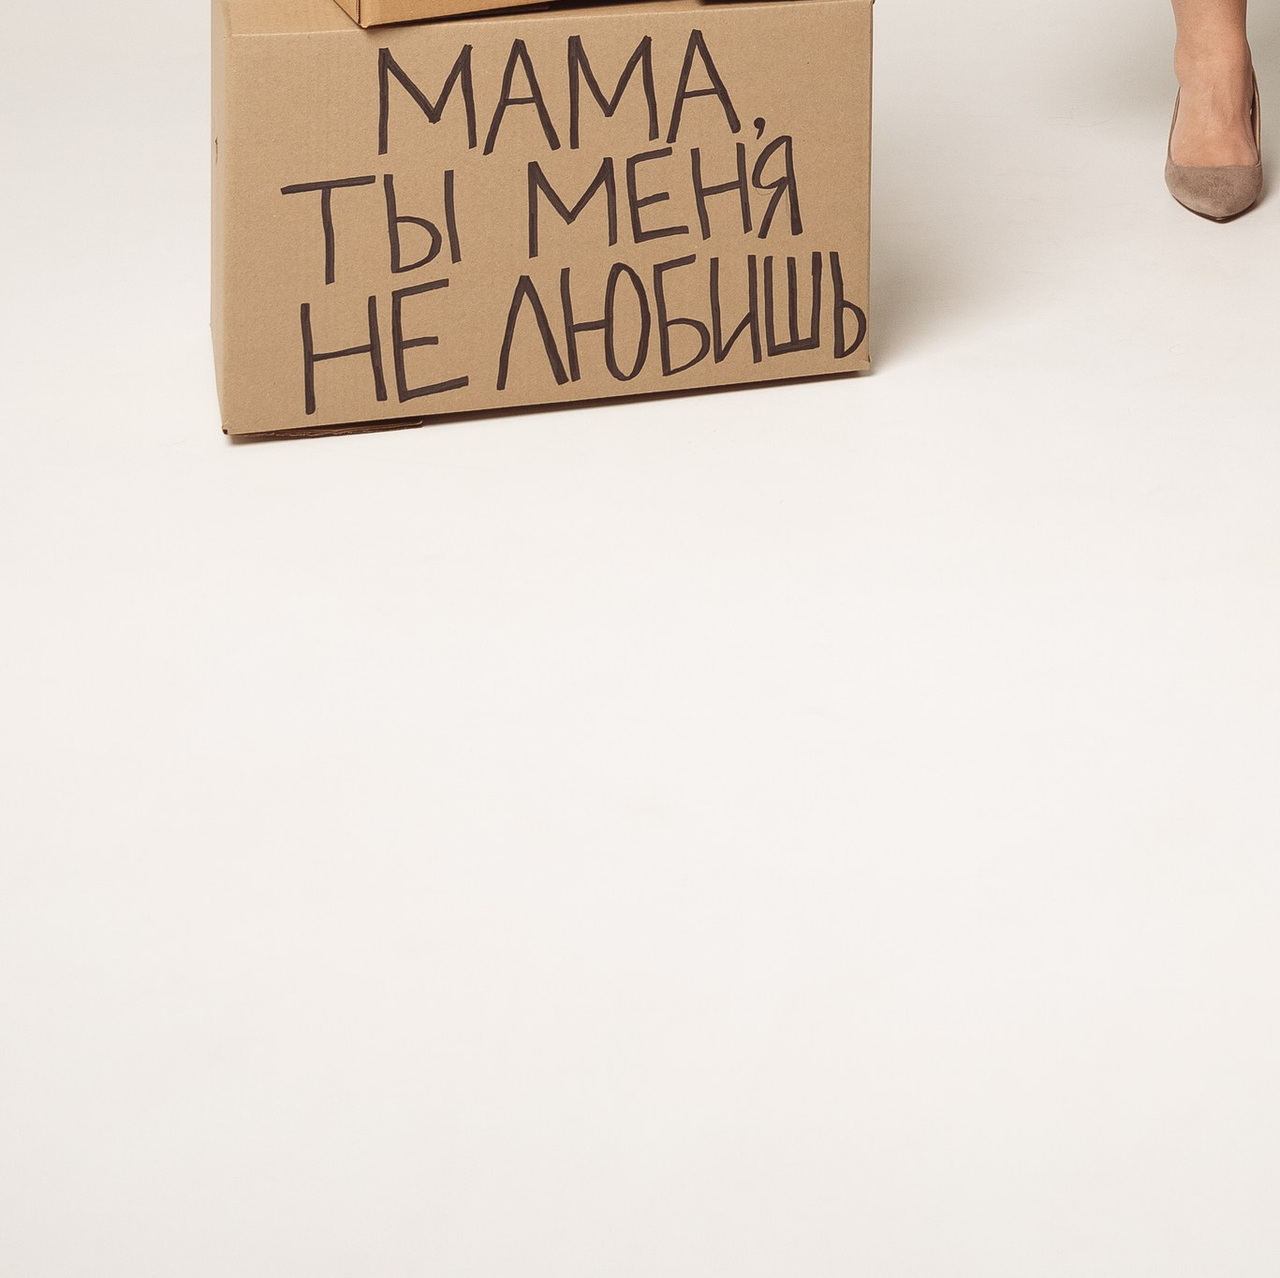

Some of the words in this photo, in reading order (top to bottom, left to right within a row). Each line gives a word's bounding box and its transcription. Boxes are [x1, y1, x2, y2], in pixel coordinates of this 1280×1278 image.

[377, 29, 768, 156] МАМА,
[281, 169, 462, 285] ТЫ
[527, 135, 805, 258] МЕНЯ
[299, 278, 469, 415] НЕ
[496, 251, 868, 391] ЛЮБИШЬ
